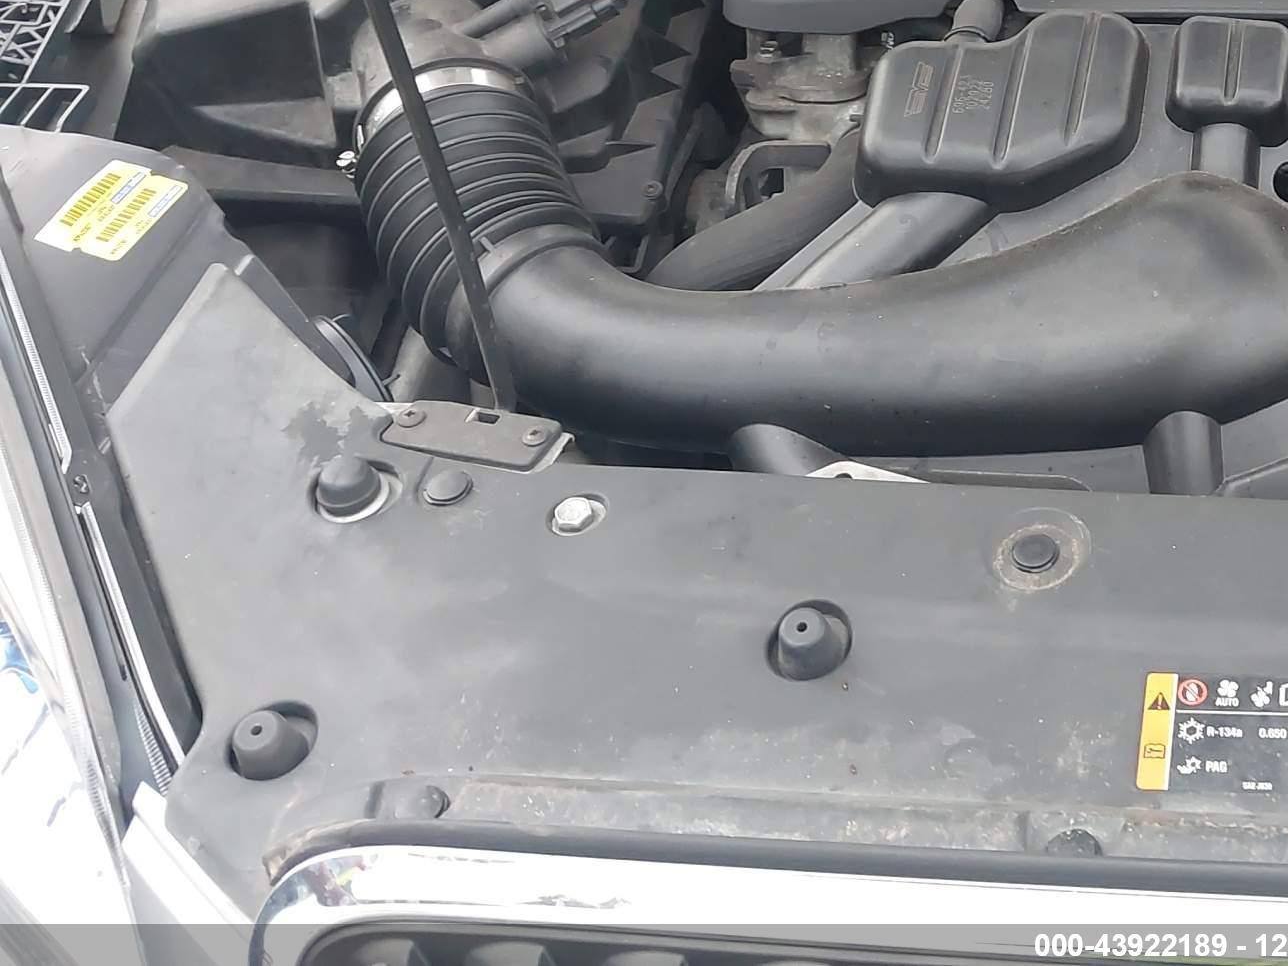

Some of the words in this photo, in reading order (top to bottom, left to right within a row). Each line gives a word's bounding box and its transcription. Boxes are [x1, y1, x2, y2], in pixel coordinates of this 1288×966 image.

[1215, 697, 1239, 707] AUTO
[1206, 726, 1243, 738] R-134a
[1205, 761, 1228, 773] PAG
